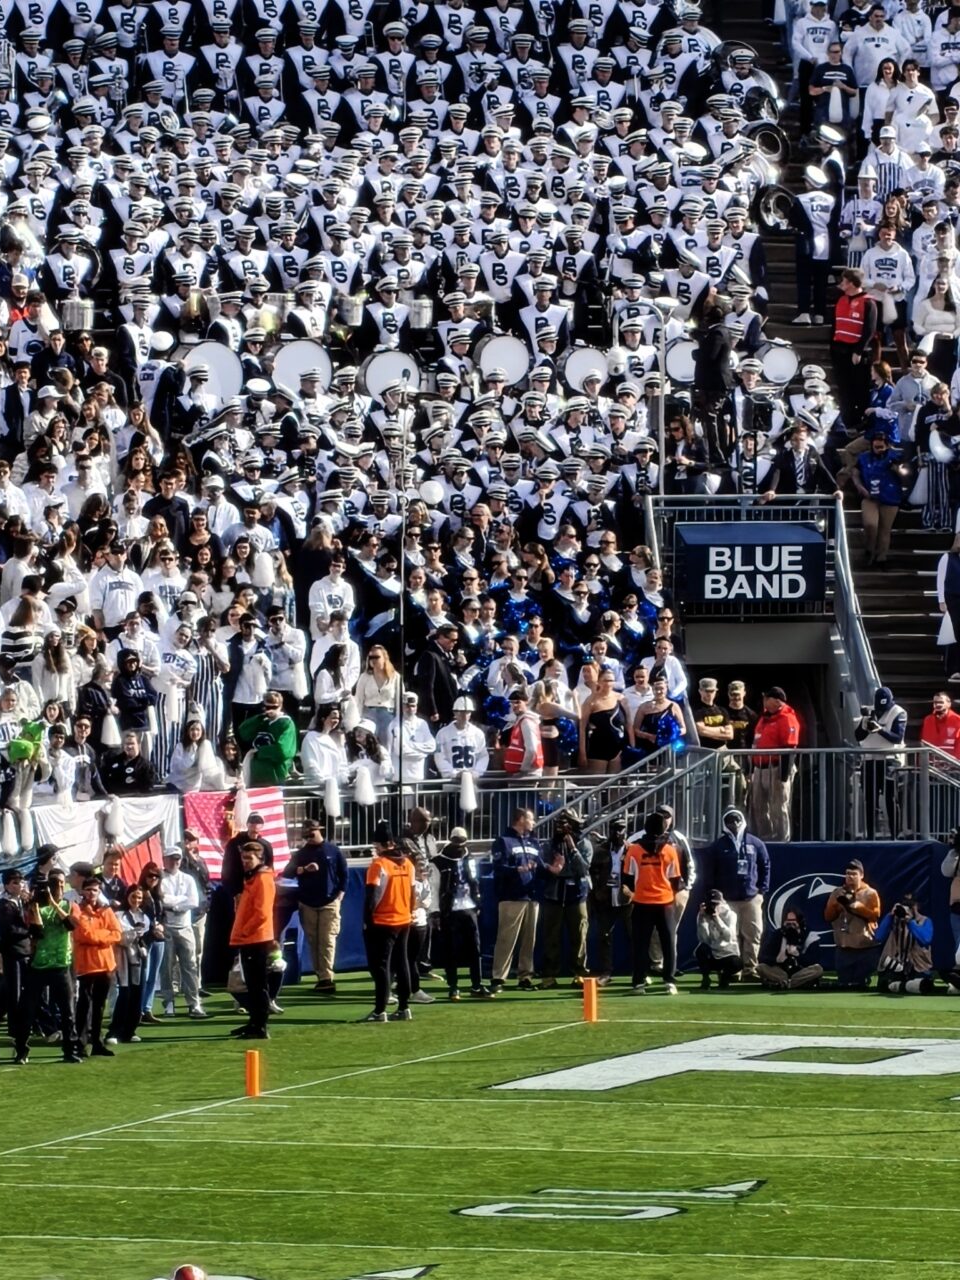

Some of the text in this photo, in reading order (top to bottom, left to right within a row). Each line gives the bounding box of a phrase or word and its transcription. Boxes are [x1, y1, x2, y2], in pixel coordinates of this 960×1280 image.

[708, 546, 803, 572] BLUE
[704, 574, 806, 599] BAND
[452, 745, 476, 768] 26
